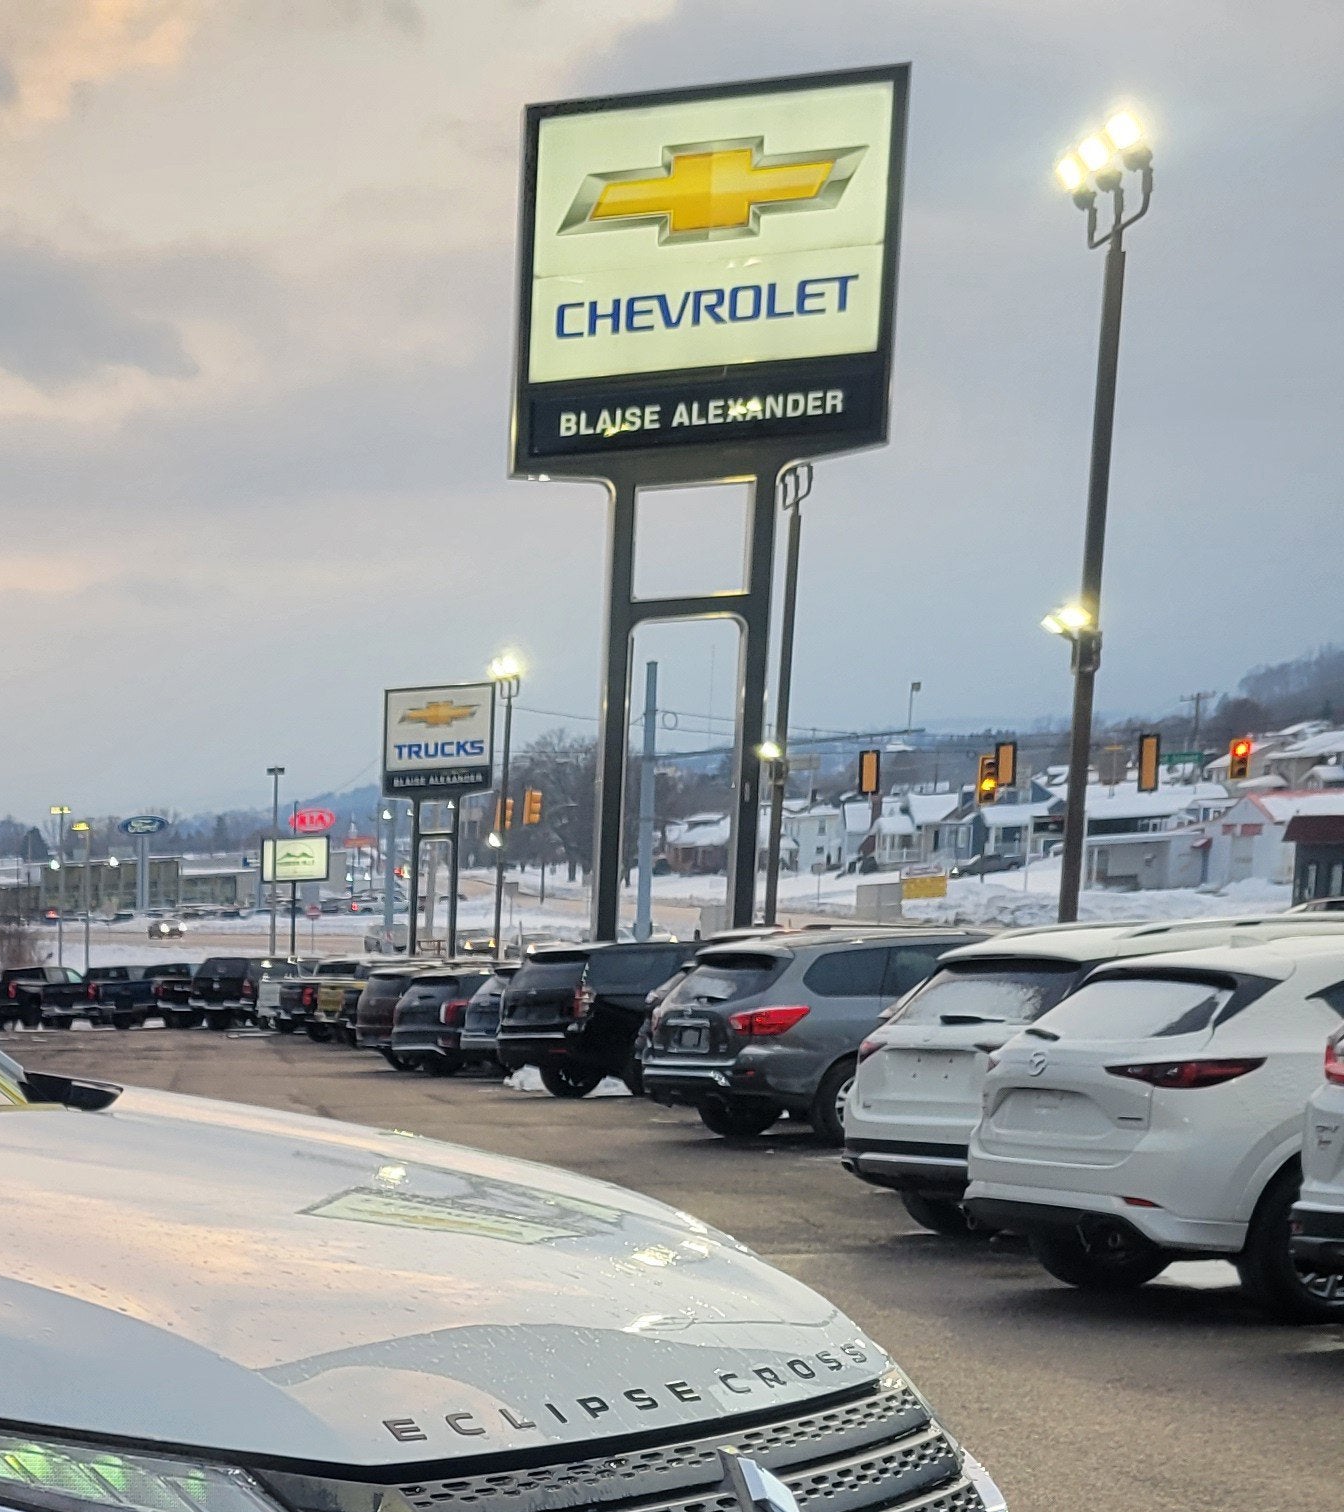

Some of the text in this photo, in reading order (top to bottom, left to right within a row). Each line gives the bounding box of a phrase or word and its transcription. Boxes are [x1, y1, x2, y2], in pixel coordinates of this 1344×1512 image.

[555, 275, 859, 339] CHEVROLET
[558, 390, 844, 438] BLAISE ALEXANDER
[393, 740, 484, 760] TRUCKS
[382, 1342, 868, 1442] ECLIPSE CROSS
